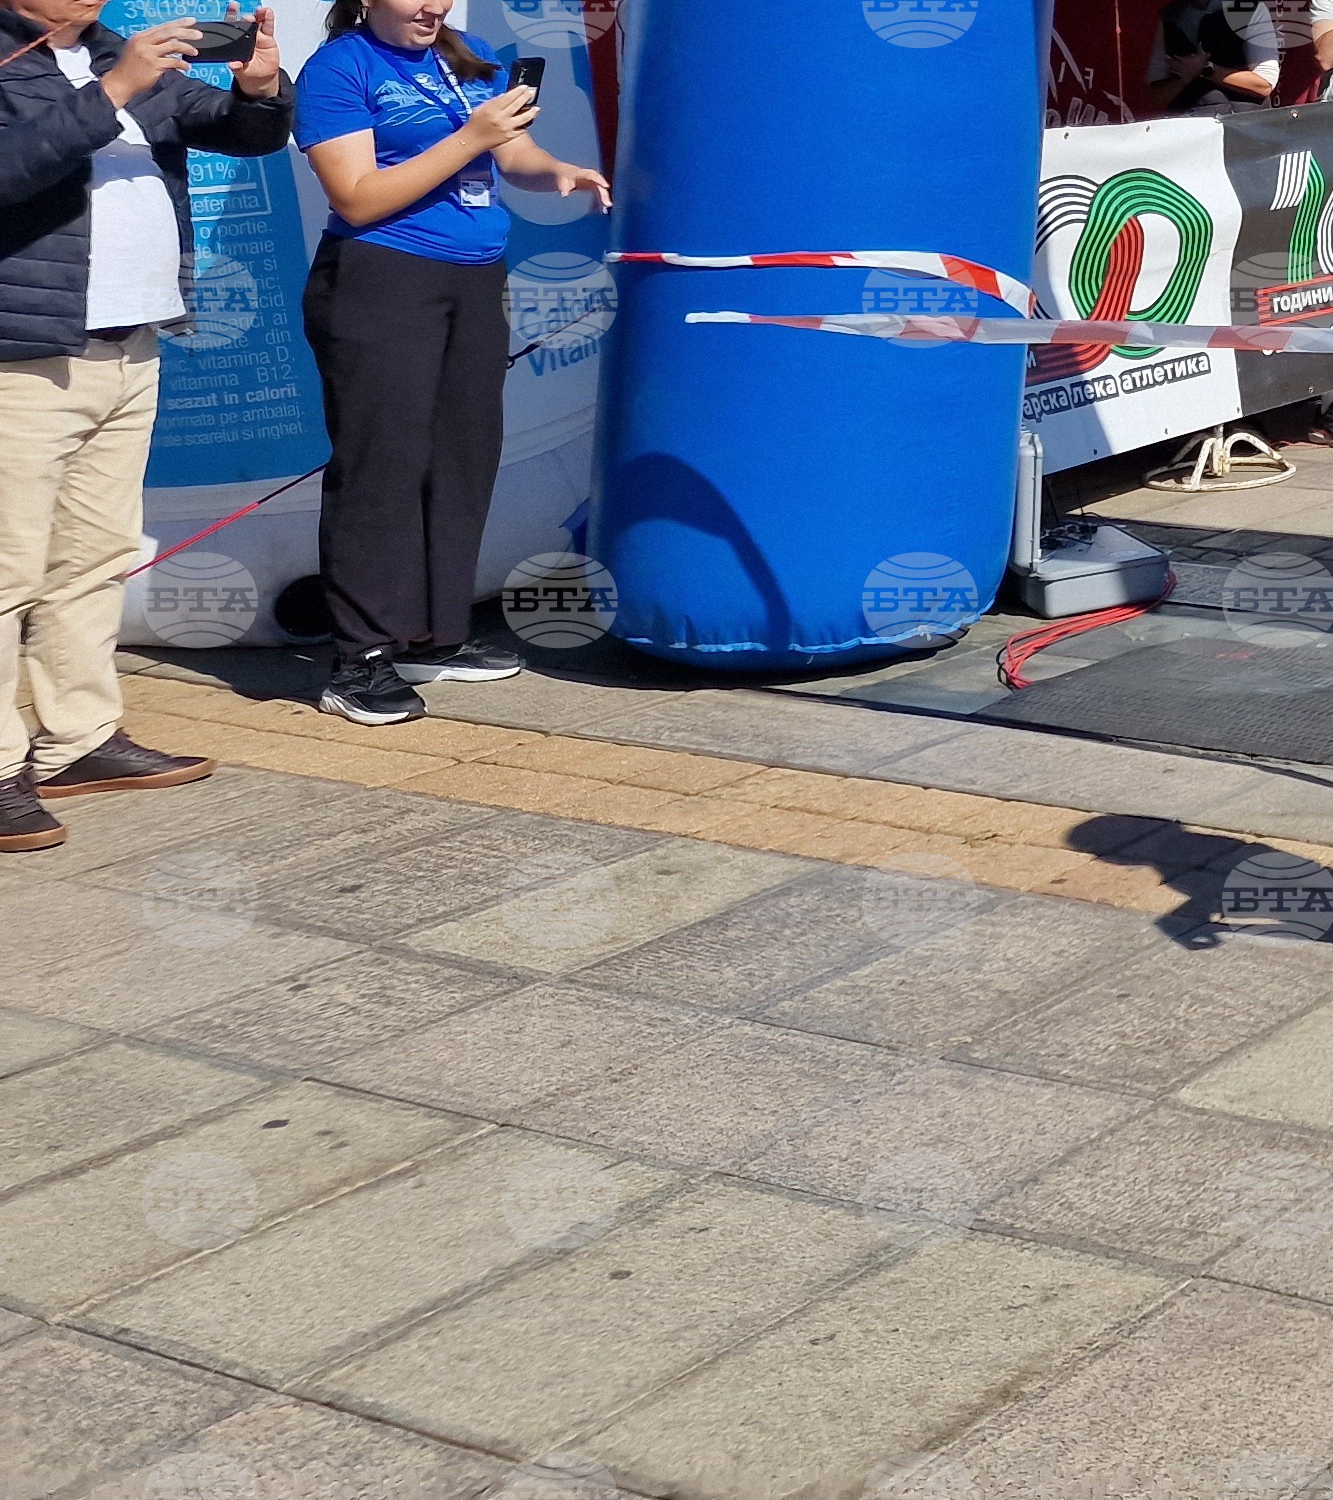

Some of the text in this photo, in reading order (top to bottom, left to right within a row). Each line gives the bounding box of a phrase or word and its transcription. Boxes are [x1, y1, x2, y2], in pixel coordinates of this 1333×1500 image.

[265, 328, 292, 346] din
[198, 350, 271, 371] vitamina
[256, 363, 299, 384] B12.
[1022, 353, 1210, 422] арска лека атлетика
